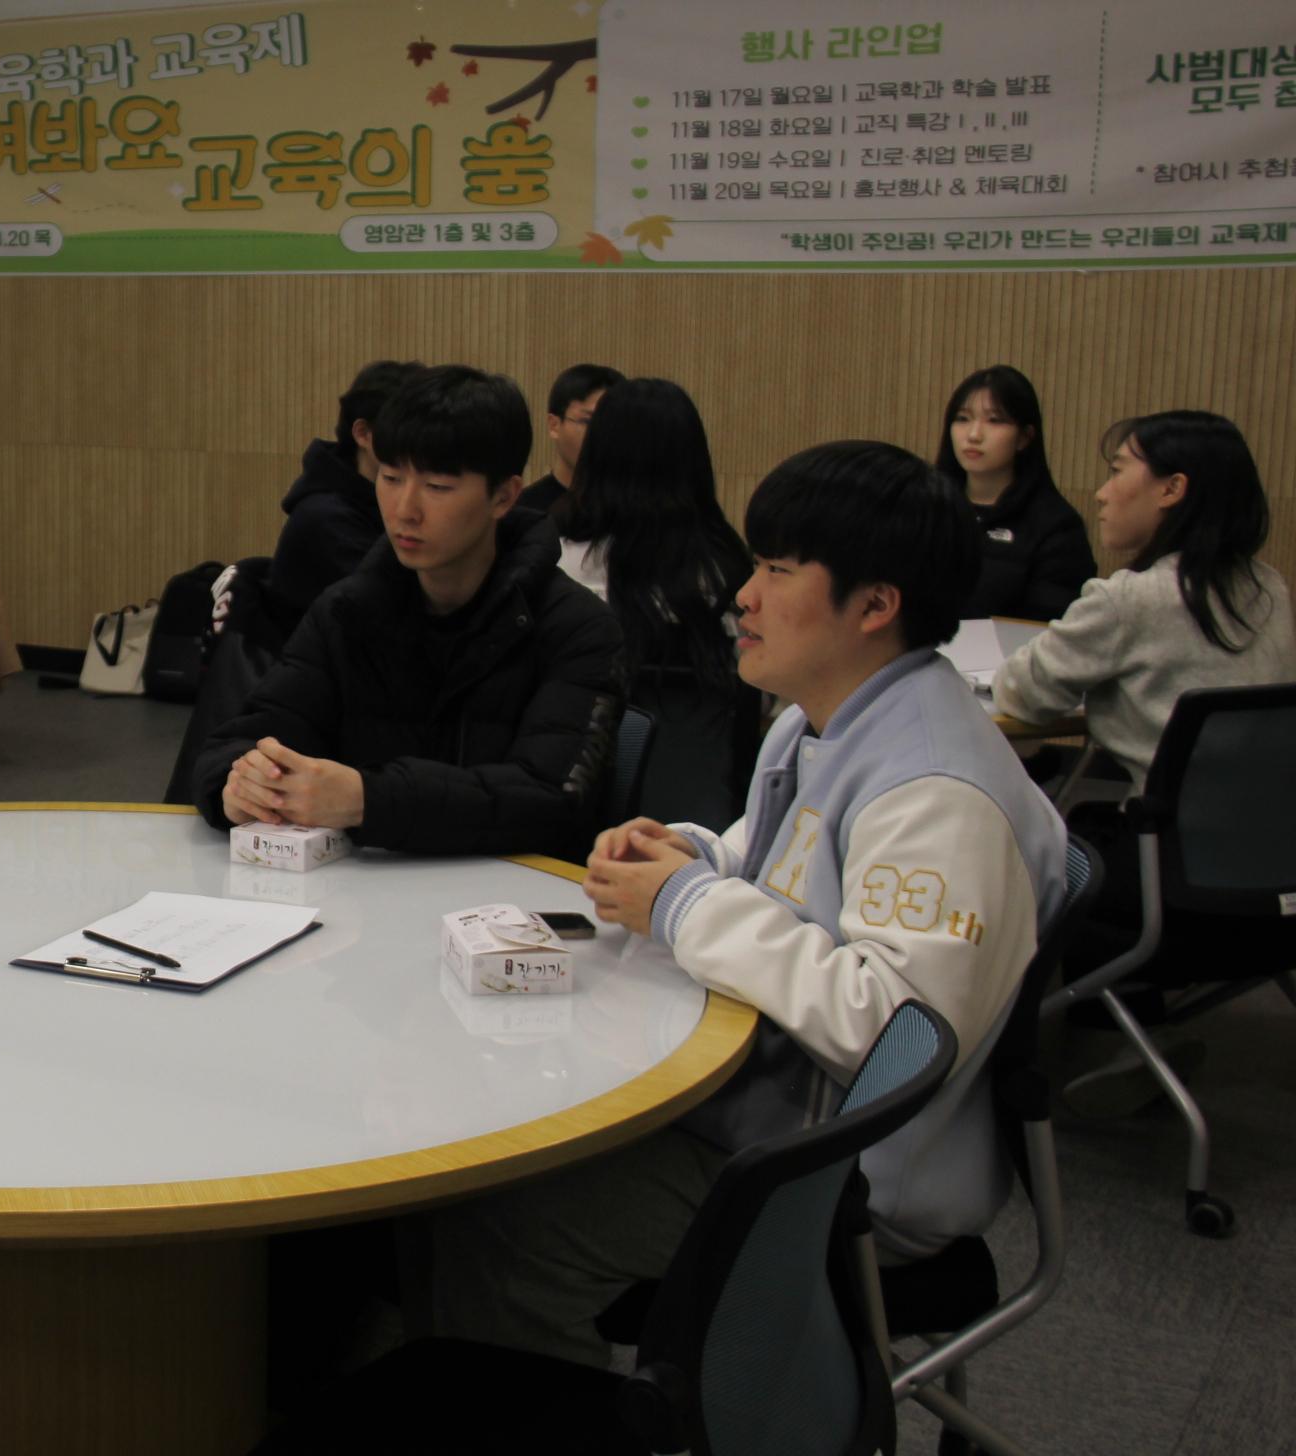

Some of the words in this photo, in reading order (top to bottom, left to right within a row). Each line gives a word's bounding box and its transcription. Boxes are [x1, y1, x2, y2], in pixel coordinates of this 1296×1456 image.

[150, 12, 307, 80] 교육제
[742, 30, 813, 62] 행사
[827, 21, 944, 59] 라인업
[673, 90, 711, 108] 11월
[719, 88, 762, 107] 17일
[770, 86, 833, 105] 월요일
[855, 80, 944, 102] 교육학과
[953, 77, 997, 98] 학술
[1006, 75, 1052, 97] 발표
[1188, 84, 1260, 114] 모두
[671, 121, 710, 138] 11월
[718, 119, 761, 137] 18일
[769, 117, 832, 136] 화요일
[854, 114, 898, 134] 교직
[906, 112, 950, 132] 특강
[182, 124, 433, 212] 교육의
[460, 121, 555, 206] 숲
[670, 153, 709, 170] 11월
[717, 151, 761, 169] 19일
[768, 149, 831, 168] 수요일
[964, 144, 1032, 164] 멘토링
[1154, 162, 1229, 183] 참여시
[1238, 157, 1296, 180] 추첨
[669, 183, 708, 200] 11월
[714, 181, 761, 200] 20일
[768, 179, 831, 199] 목요일
[853, 177, 942, 198] 홍보행사
[949, 179, 967, 196] &
[975, 174, 1067, 195] 체육대회
[35, 230, 51, 246] 목
[364, 224, 426, 244] 영암관
[434, 223, 464, 242] 1층
[472, 222, 491, 242] 및
[500, 221, 535, 241] 3층
[861, 231, 935, 250] 주인공!
[943, 231, 1012, 250] 우리가
[1020, 229, 1093, 249] 만드는
[1102, 225, 1200, 247] 우리들의
